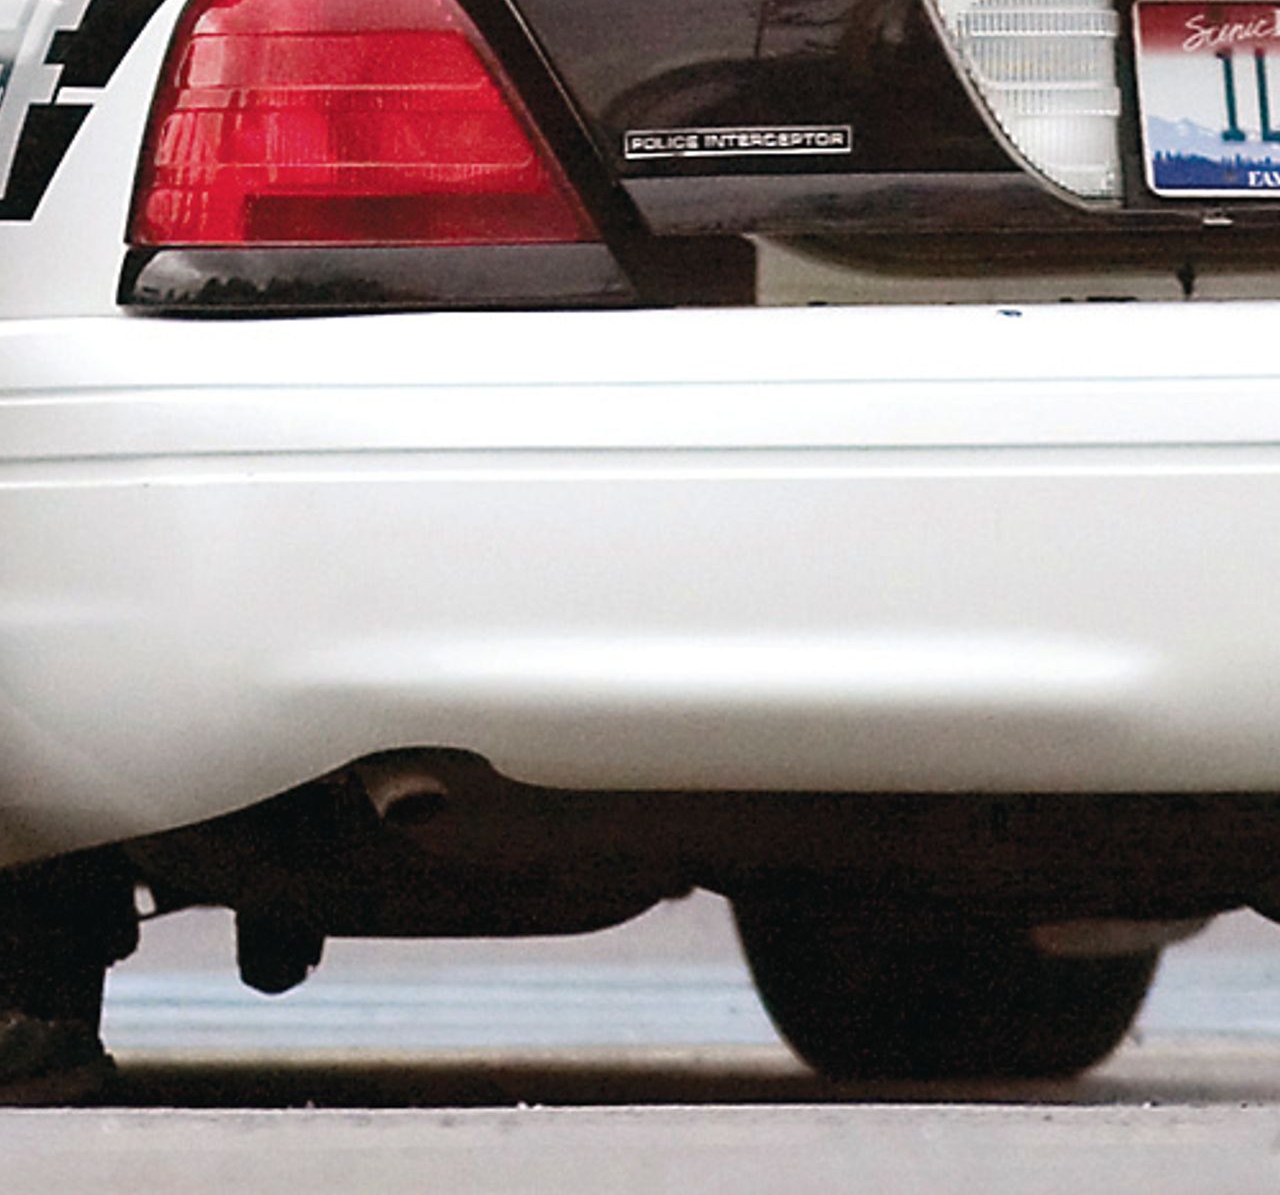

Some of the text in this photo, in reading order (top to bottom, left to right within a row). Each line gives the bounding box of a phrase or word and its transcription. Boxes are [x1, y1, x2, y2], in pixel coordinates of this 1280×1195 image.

[1181, 14, 1276, 51] Scenic
[631, 132, 845, 151] POLICE INTERCEPTOR
